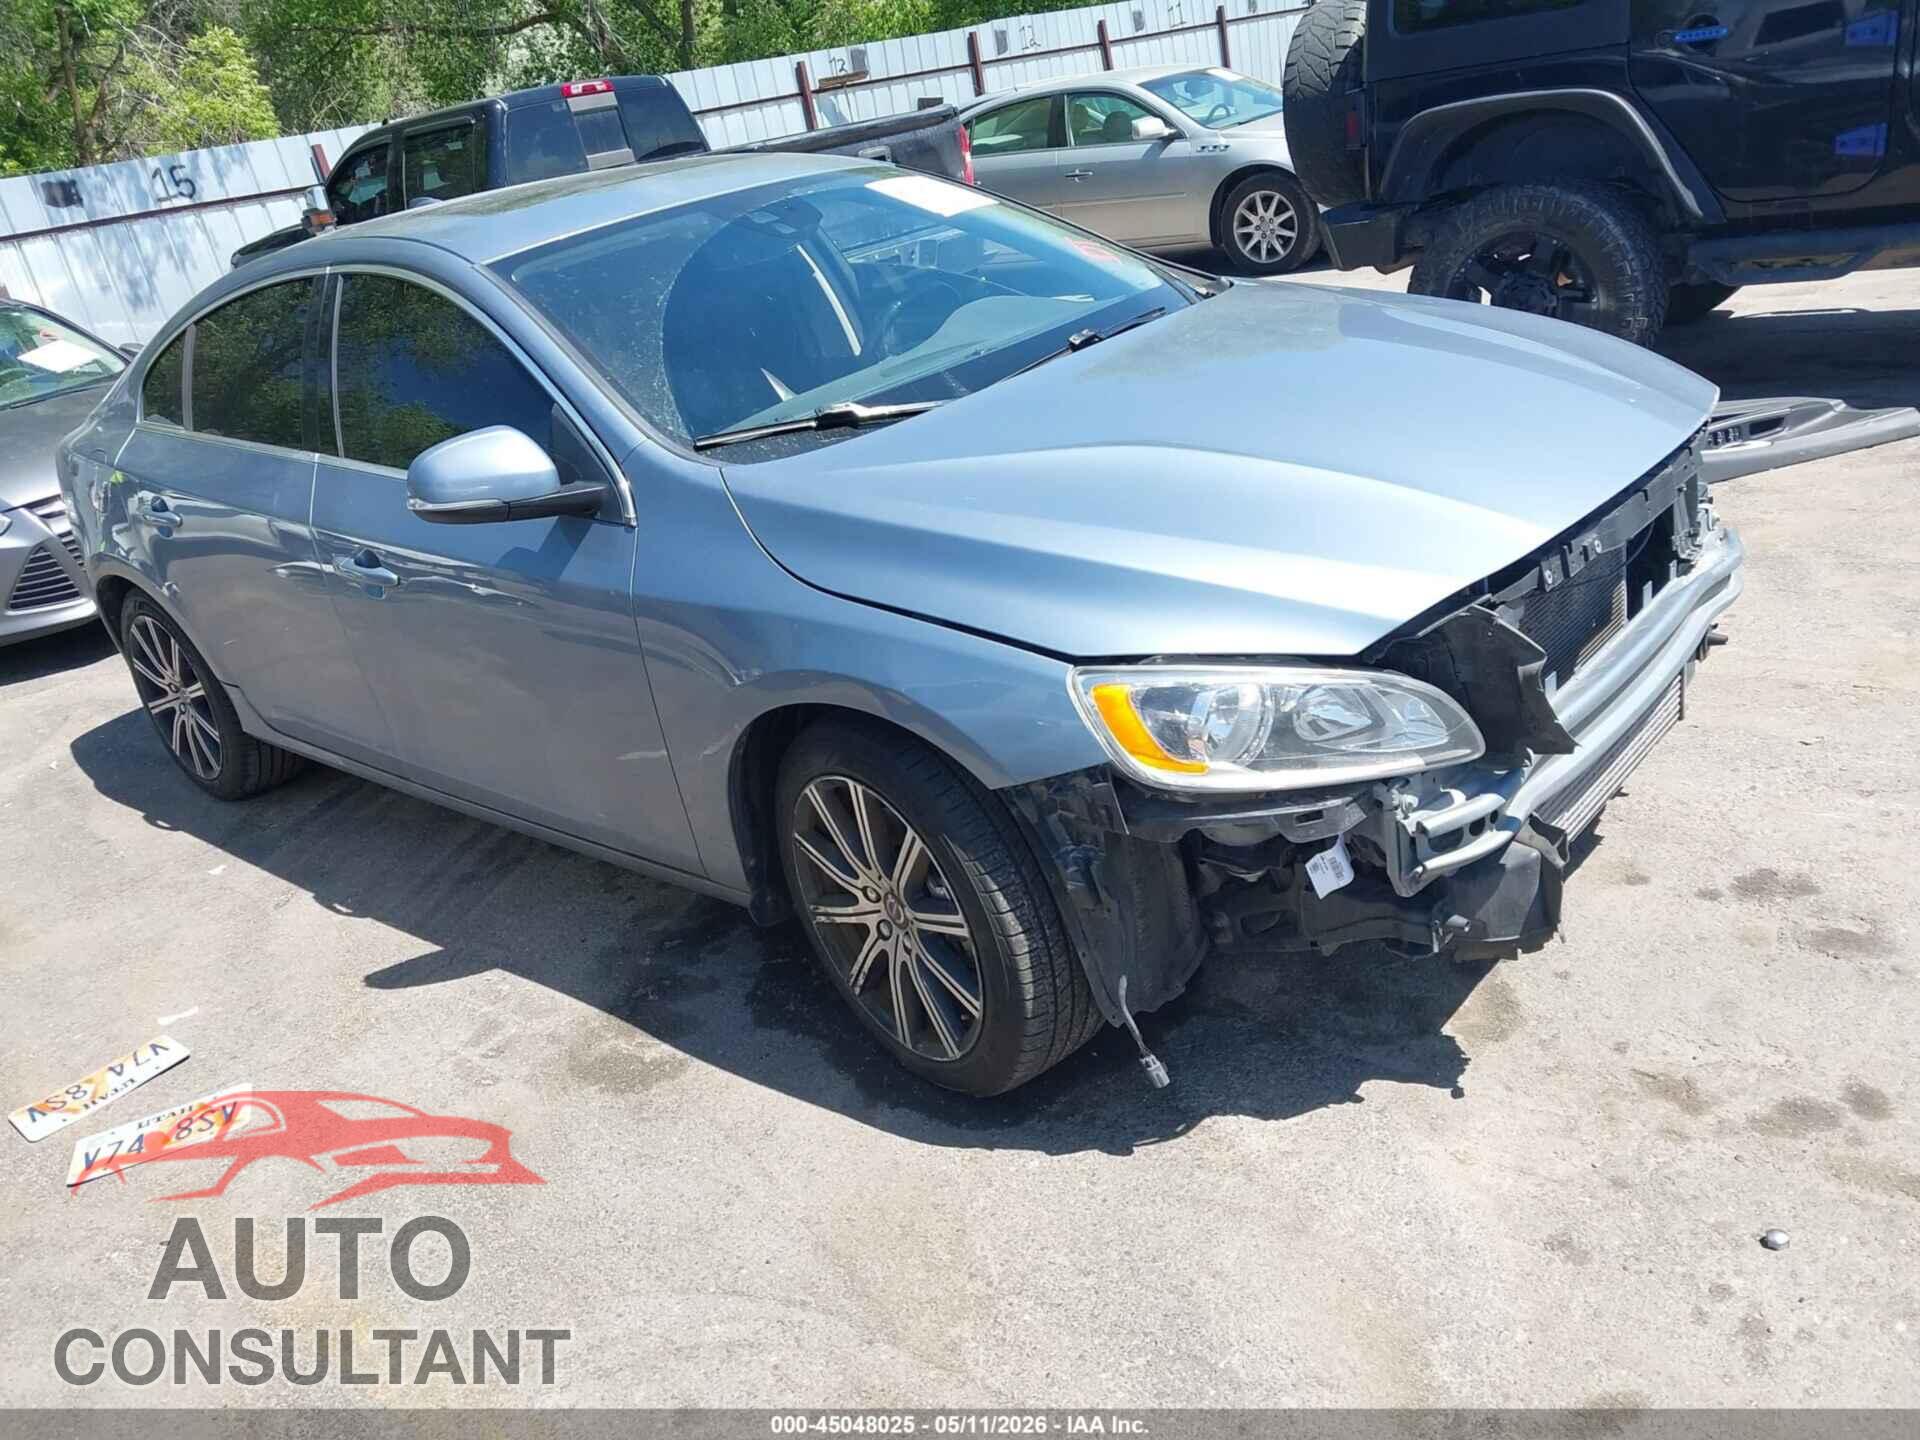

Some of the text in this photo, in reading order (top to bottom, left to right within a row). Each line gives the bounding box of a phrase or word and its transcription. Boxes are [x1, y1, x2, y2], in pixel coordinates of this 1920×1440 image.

[151, 164, 197, 203] 15
[26, 1084, 88, 1123] 8SV
[84, 1102, 237, 1170] V74 8SV
